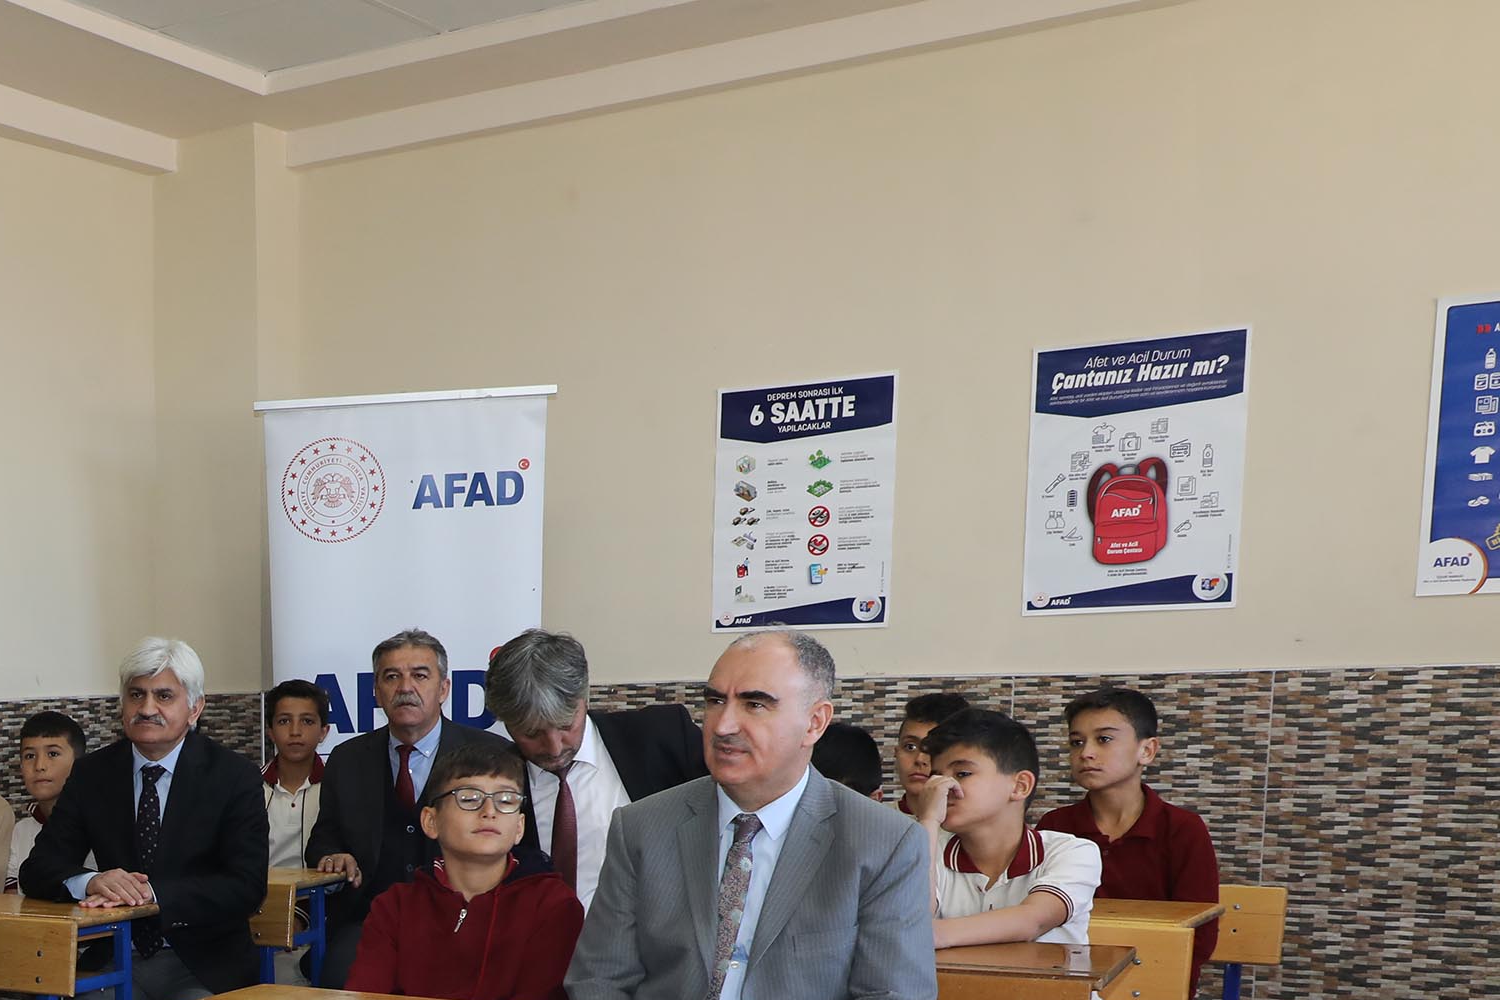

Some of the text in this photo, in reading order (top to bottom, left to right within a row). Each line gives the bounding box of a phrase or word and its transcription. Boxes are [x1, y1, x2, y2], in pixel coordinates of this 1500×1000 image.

[1084, 347, 1191, 369] Afet ve Acil Durum
[1052, 368, 1132, 394] Çantanız
[1136, 363, 1188, 382] Hazır
[1190, 354, 1230, 377] mı?
[766, 386, 844, 402] DEPREM SONRASI İLK
[749, 395, 856, 426] 6 SAATTE
[777, 421, 832, 434] YAPILACAKLAR
[412, 470, 525, 510] AFAD
[1110, 506, 1141, 519] AFAD
[1432, 555, 1470, 568] AFAD
[1050, 597, 1071, 606] AFAD
[734, 617, 752, 625] AFAD
